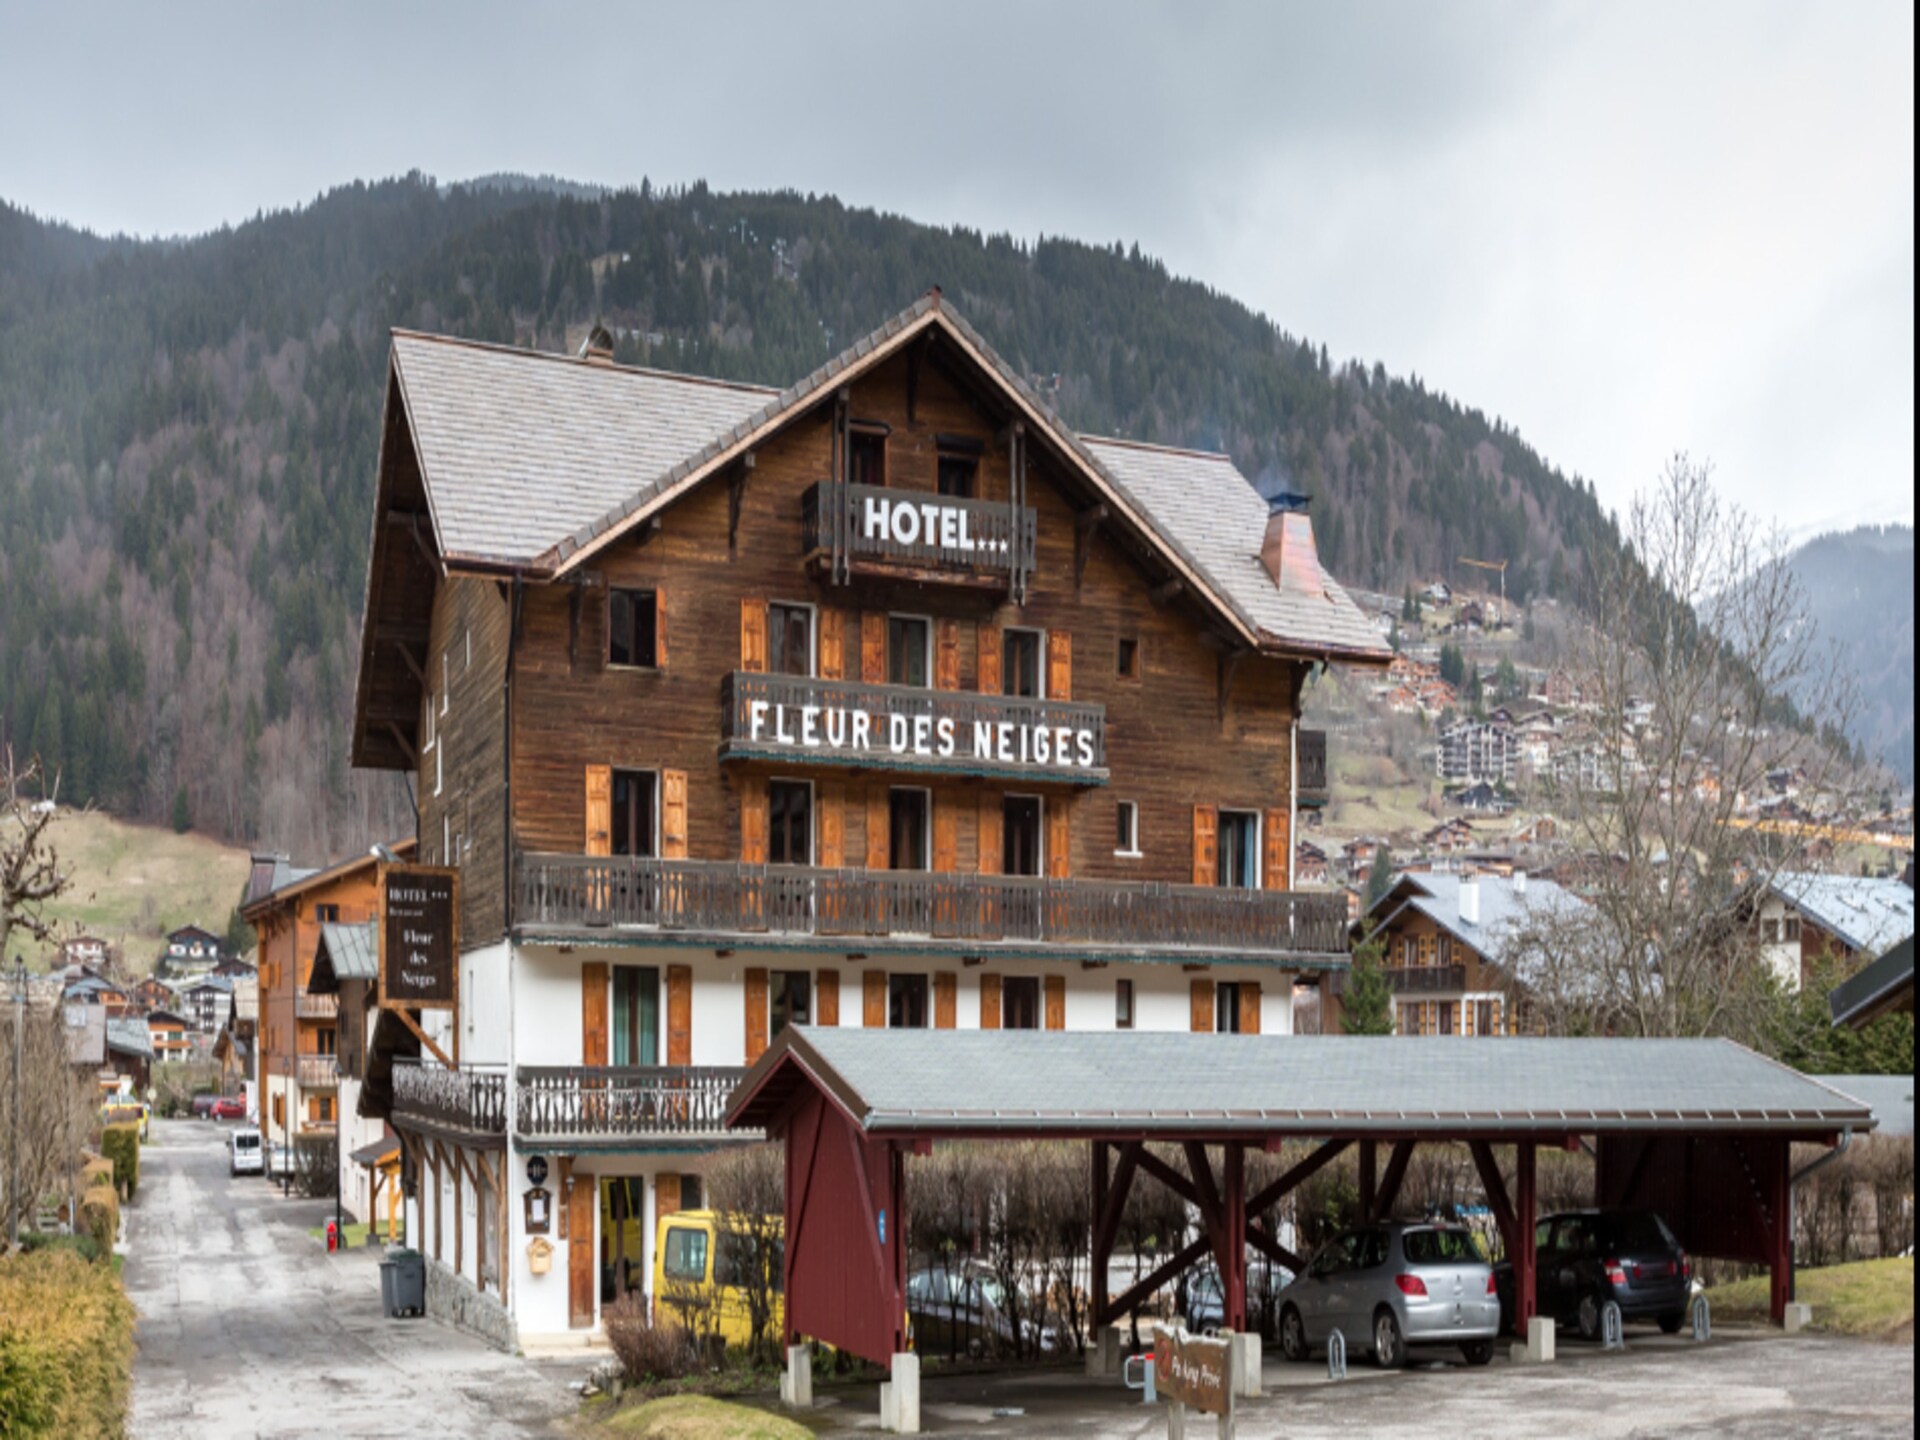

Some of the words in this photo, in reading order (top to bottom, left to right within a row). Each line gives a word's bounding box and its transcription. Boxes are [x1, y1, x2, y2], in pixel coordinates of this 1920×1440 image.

[864, 497, 975, 551] HOTEL
[750, 700, 870, 751] FLEUR
[889, 713, 955, 757] DES
[973, 720, 1095, 767] NEIGES
[404, 930, 433, 945] Fleur
[410, 951, 428, 964] des
[402, 971, 436, 988] Neiges
